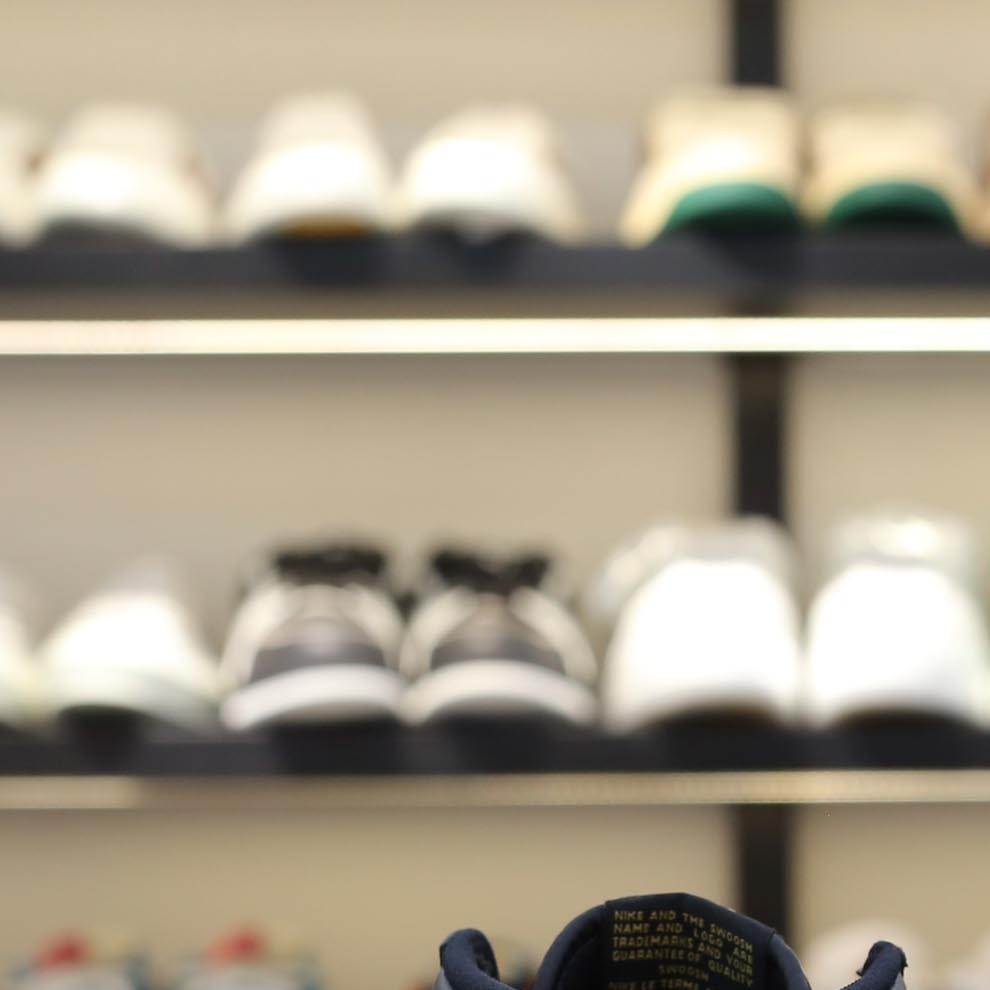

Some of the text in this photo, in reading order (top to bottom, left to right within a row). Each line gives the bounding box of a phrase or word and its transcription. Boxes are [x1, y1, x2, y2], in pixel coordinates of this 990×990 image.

[613, 923, 651, 934] NAME
[656, 923, 683, 934] AND
[693, 928, 724, 948] LOGO
[614, 910, 753, 953] NIKE AND THE SWOOSH
[697, 943, 721, 960] AND
